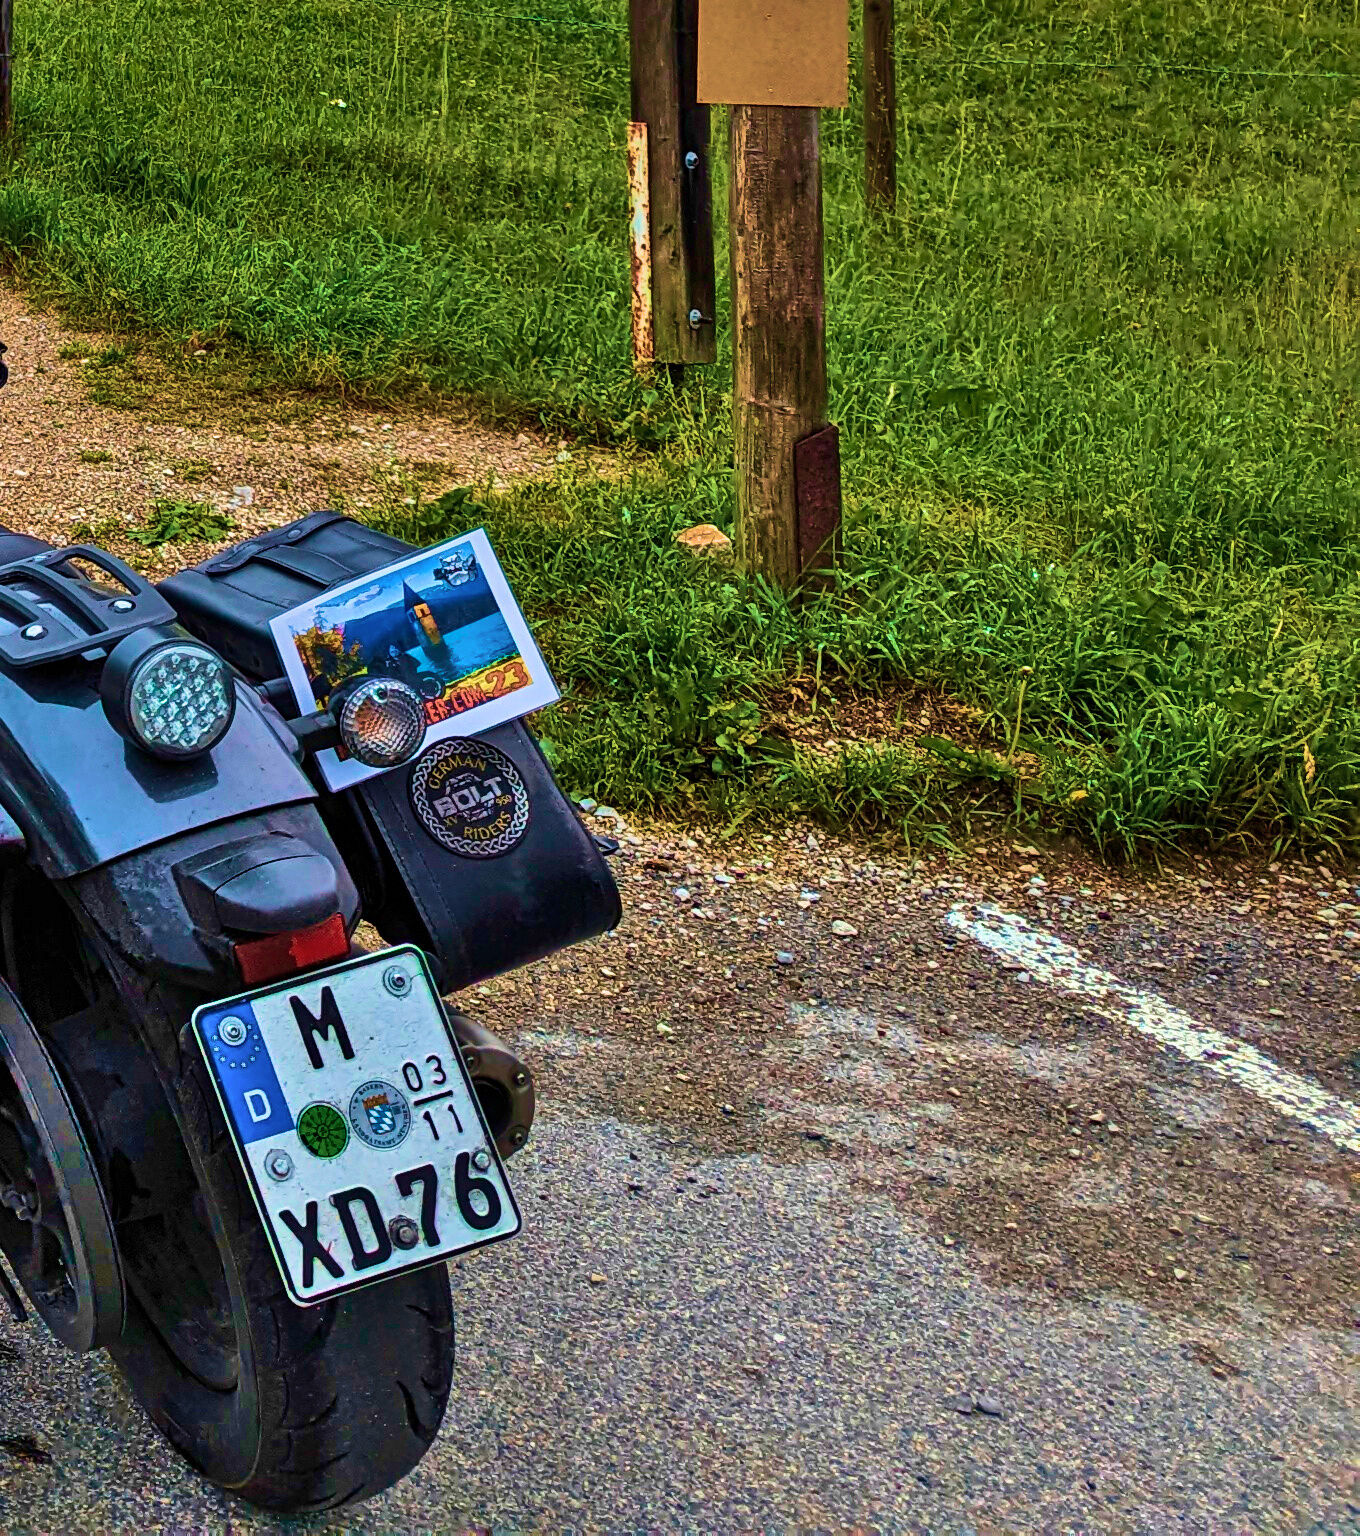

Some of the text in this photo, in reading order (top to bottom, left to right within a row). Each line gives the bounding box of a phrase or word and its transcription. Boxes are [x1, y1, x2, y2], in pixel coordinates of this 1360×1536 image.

[428, 754, 487, 790] GERMAN
[432, 776, 502, 818] BOLT
[463, 810, 512, 840] RIDERS
[289, 985, 356, 1069] M
[243, 1054, 448, 1123] D 03
[422, 1103, 463, 1141] 11
